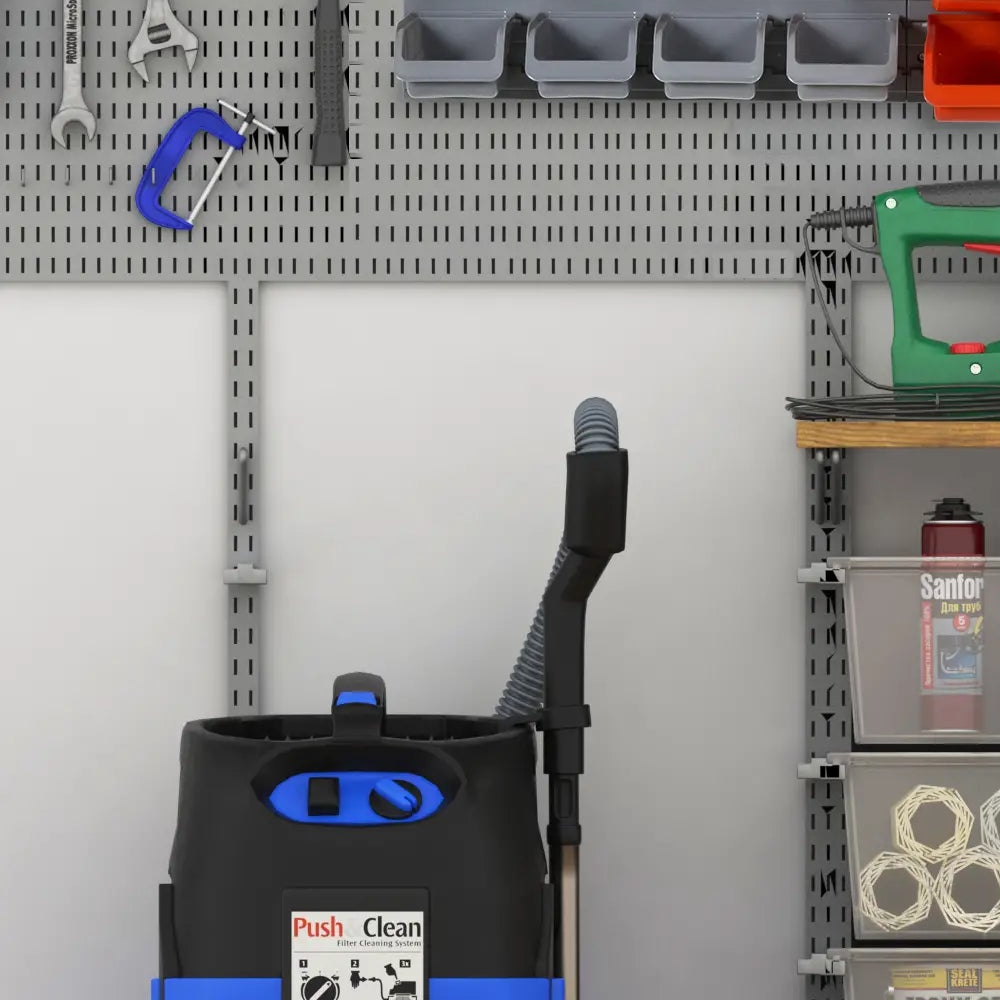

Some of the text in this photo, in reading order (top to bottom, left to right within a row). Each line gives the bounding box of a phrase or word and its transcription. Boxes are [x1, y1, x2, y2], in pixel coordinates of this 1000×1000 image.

[66, 32, 77, 64] PROXXON
[920, 573, 984, 599] Sanfor
[941, 601, 981, 614] Для труб
[958, 616, 965, 625] 5
[294, 916, 421, 937] Push Clean
[360, 939, 393, 948] Cleaning
[950, 968, 977, 979] SEAL
